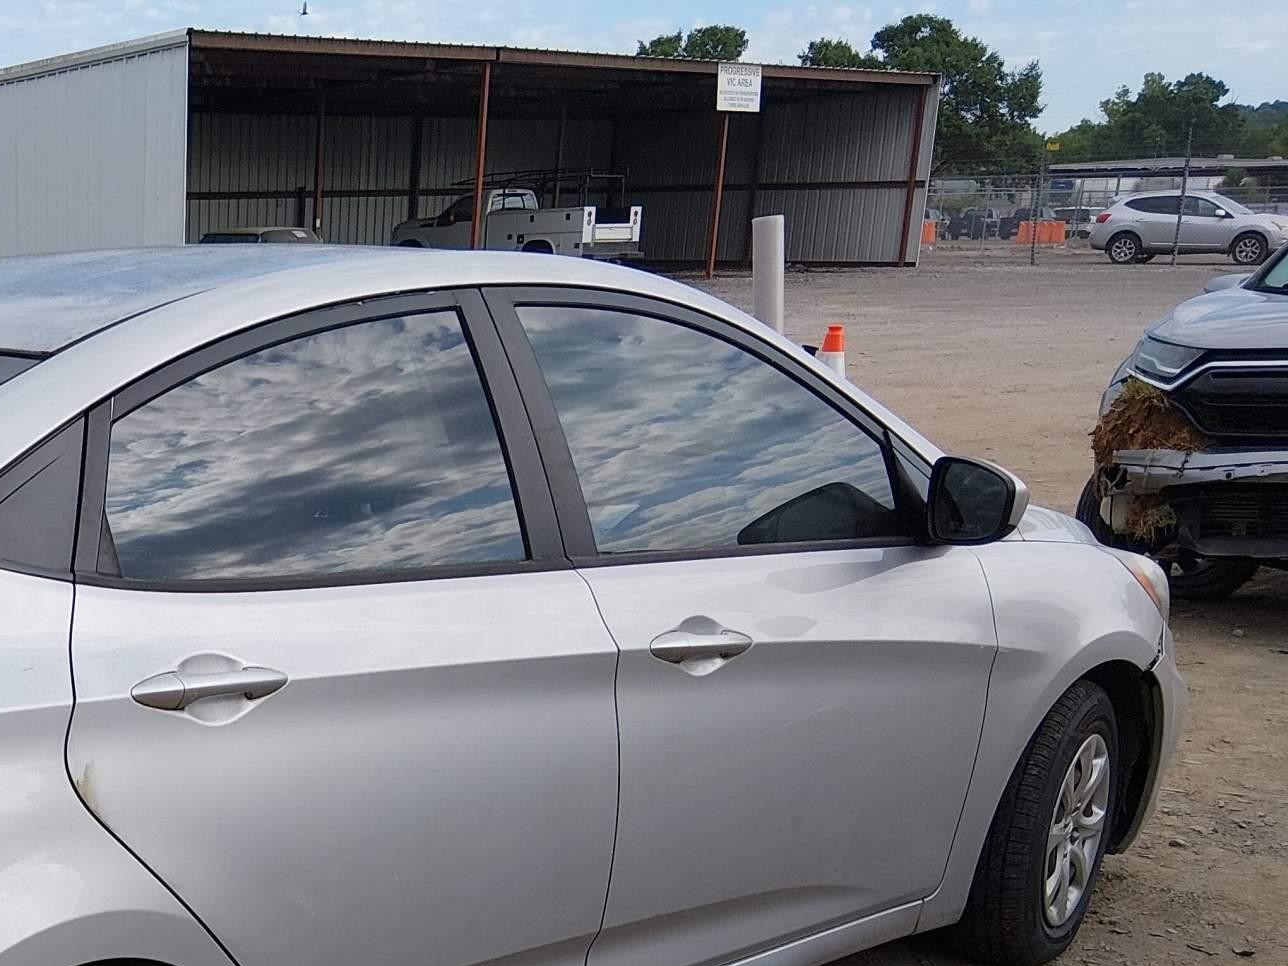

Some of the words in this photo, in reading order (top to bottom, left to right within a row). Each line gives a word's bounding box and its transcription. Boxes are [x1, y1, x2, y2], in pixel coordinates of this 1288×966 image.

[720, 66, 760, 77] PROGRESSIVE
[727, 77, 736, 87] VIC
[737, 78, 753, 87] AREA
